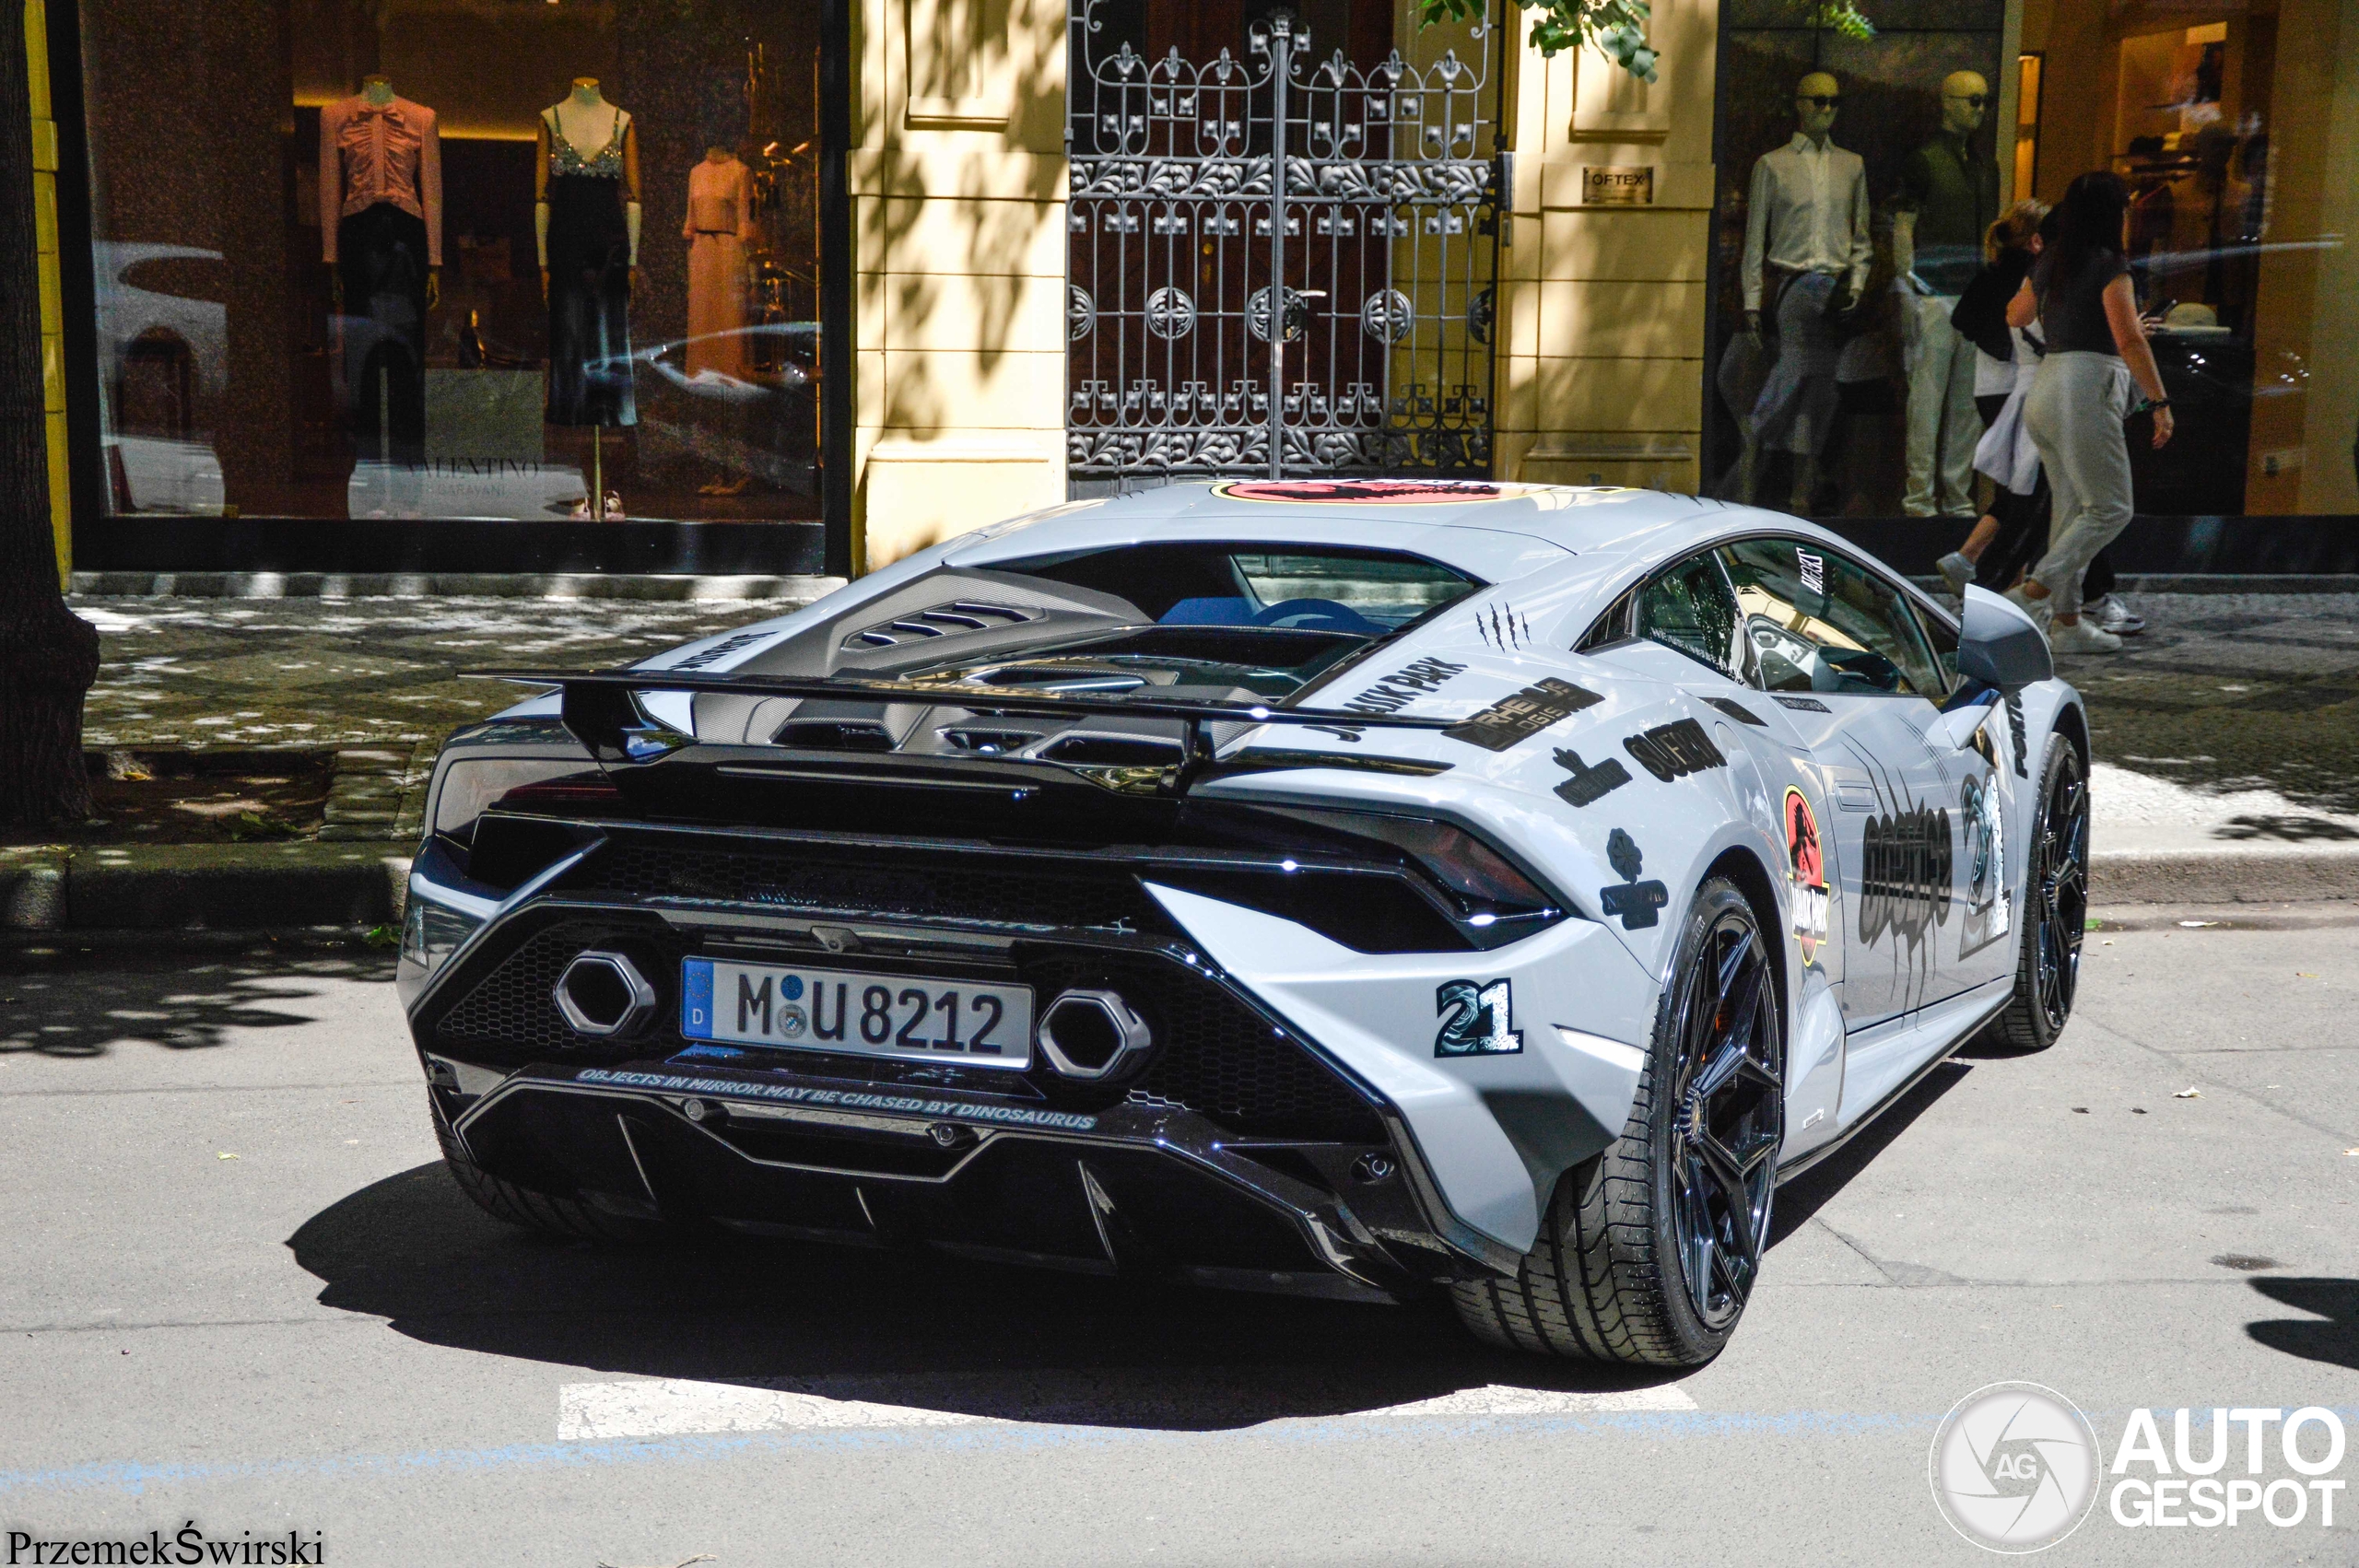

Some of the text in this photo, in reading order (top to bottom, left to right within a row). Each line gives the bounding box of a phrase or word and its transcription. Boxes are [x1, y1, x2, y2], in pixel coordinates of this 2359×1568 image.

[1591, 173, 1645, 185] OFTEX
[405, 457, 540, 479] VALENTINO
[1379, 656, 1470, 693] PARK
[692, 1008, 704, 1024] D
[738, 973, 772, 1036] M
[812, 981, 847, 1041] U
[859, 985, 1003, 1055] 8212
[1434, 977, 1524, 1059] 21
[576, 1068, 1099, 1130] OBJECTS IN MIRROR MAY BE CHASED BY DINOSAURUS
